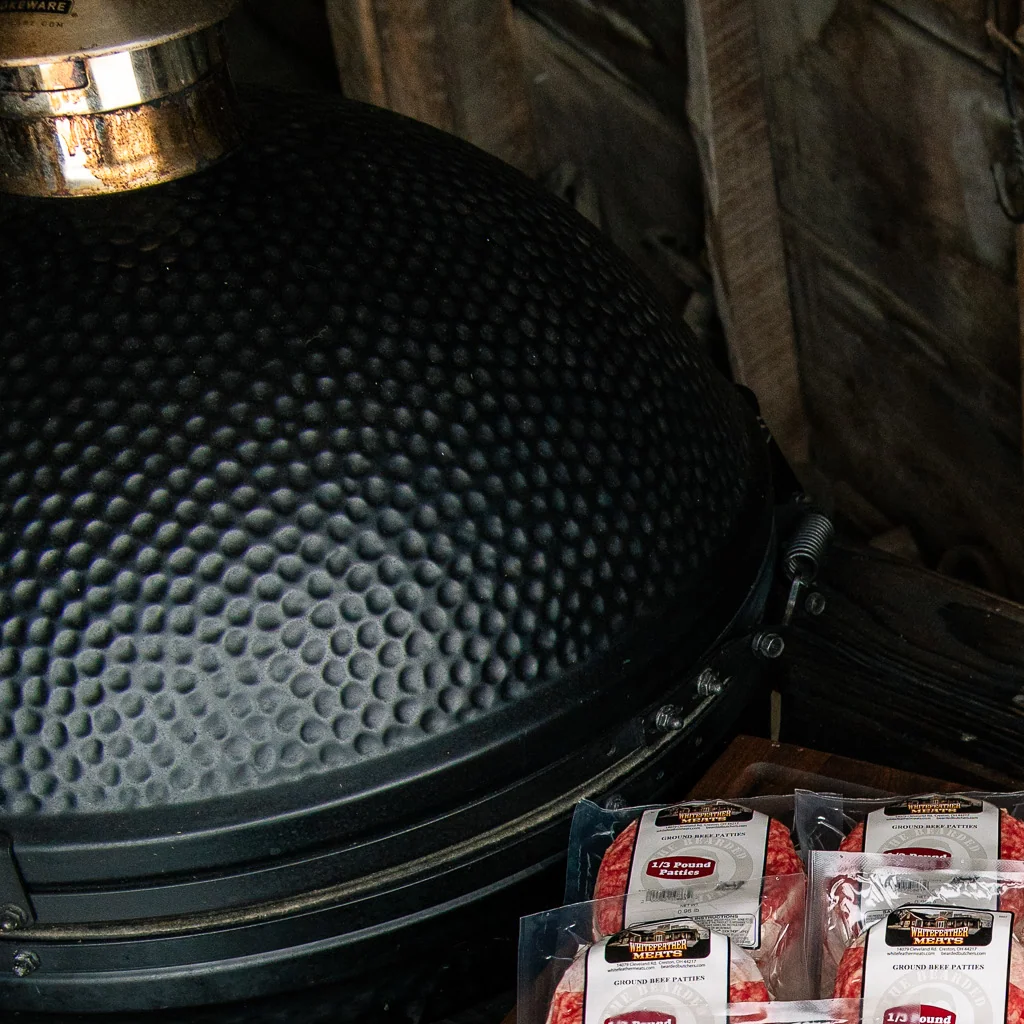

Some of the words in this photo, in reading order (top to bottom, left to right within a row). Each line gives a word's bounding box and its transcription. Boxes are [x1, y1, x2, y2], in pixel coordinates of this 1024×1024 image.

[679, 810, 731, 819] WHITEFEATHER
[651, 861, 670, 869] 1/3
[673, 861, 712, 869] Pound
[659, 868, 700, 876] Patties
[911, 926, 969, 938] WHITEFEATHER
[913, 937, 964, 945] MEATS
[629, 939, 688, 953] WHITEFEATHER
[632, 950, 683, 960] MEATS
[672, 975, 705, 983] PATTIES
[887, 1012, 908, 1023] 1/3
